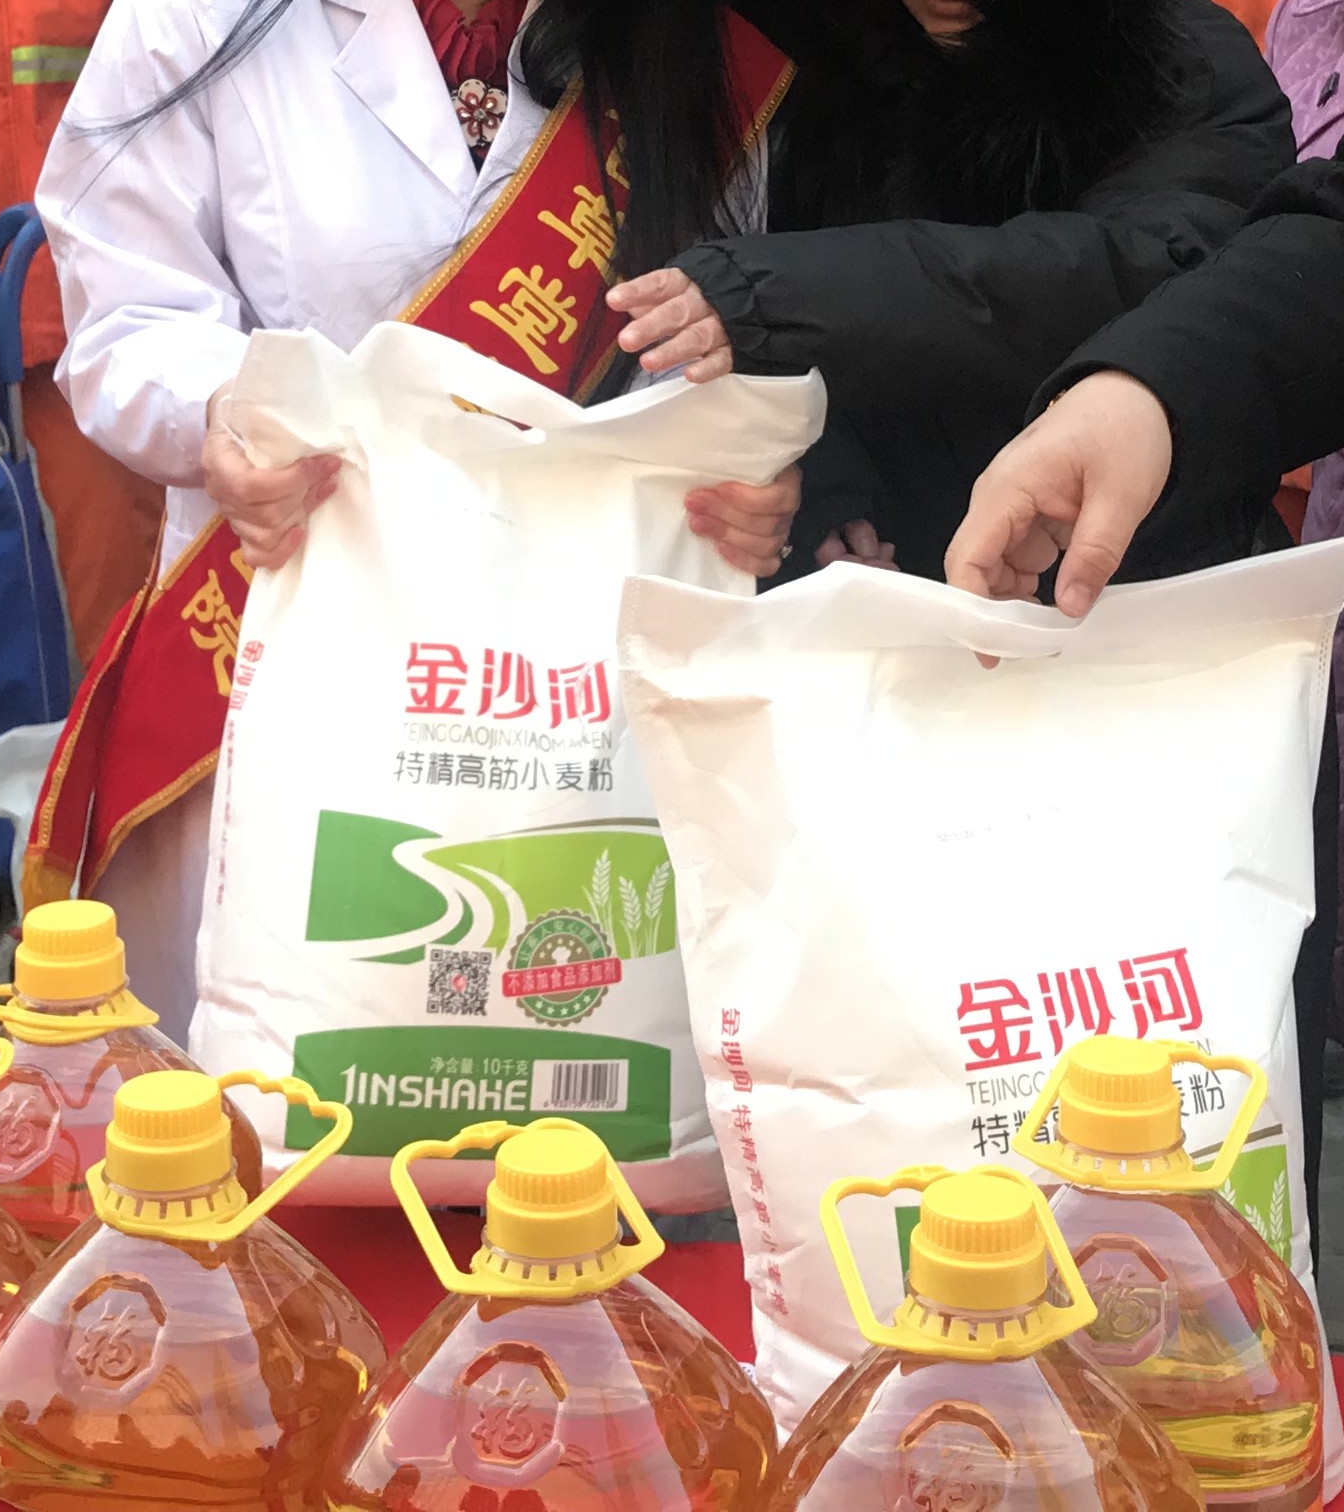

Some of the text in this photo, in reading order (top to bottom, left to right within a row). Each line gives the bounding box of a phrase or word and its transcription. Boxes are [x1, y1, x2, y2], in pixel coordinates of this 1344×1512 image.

[404, 641, 613, 730] 金沙河
[392, 750, 615, 793] 特精高筋小麦粉
[956, 947, 1203, 1072] 金沙河
